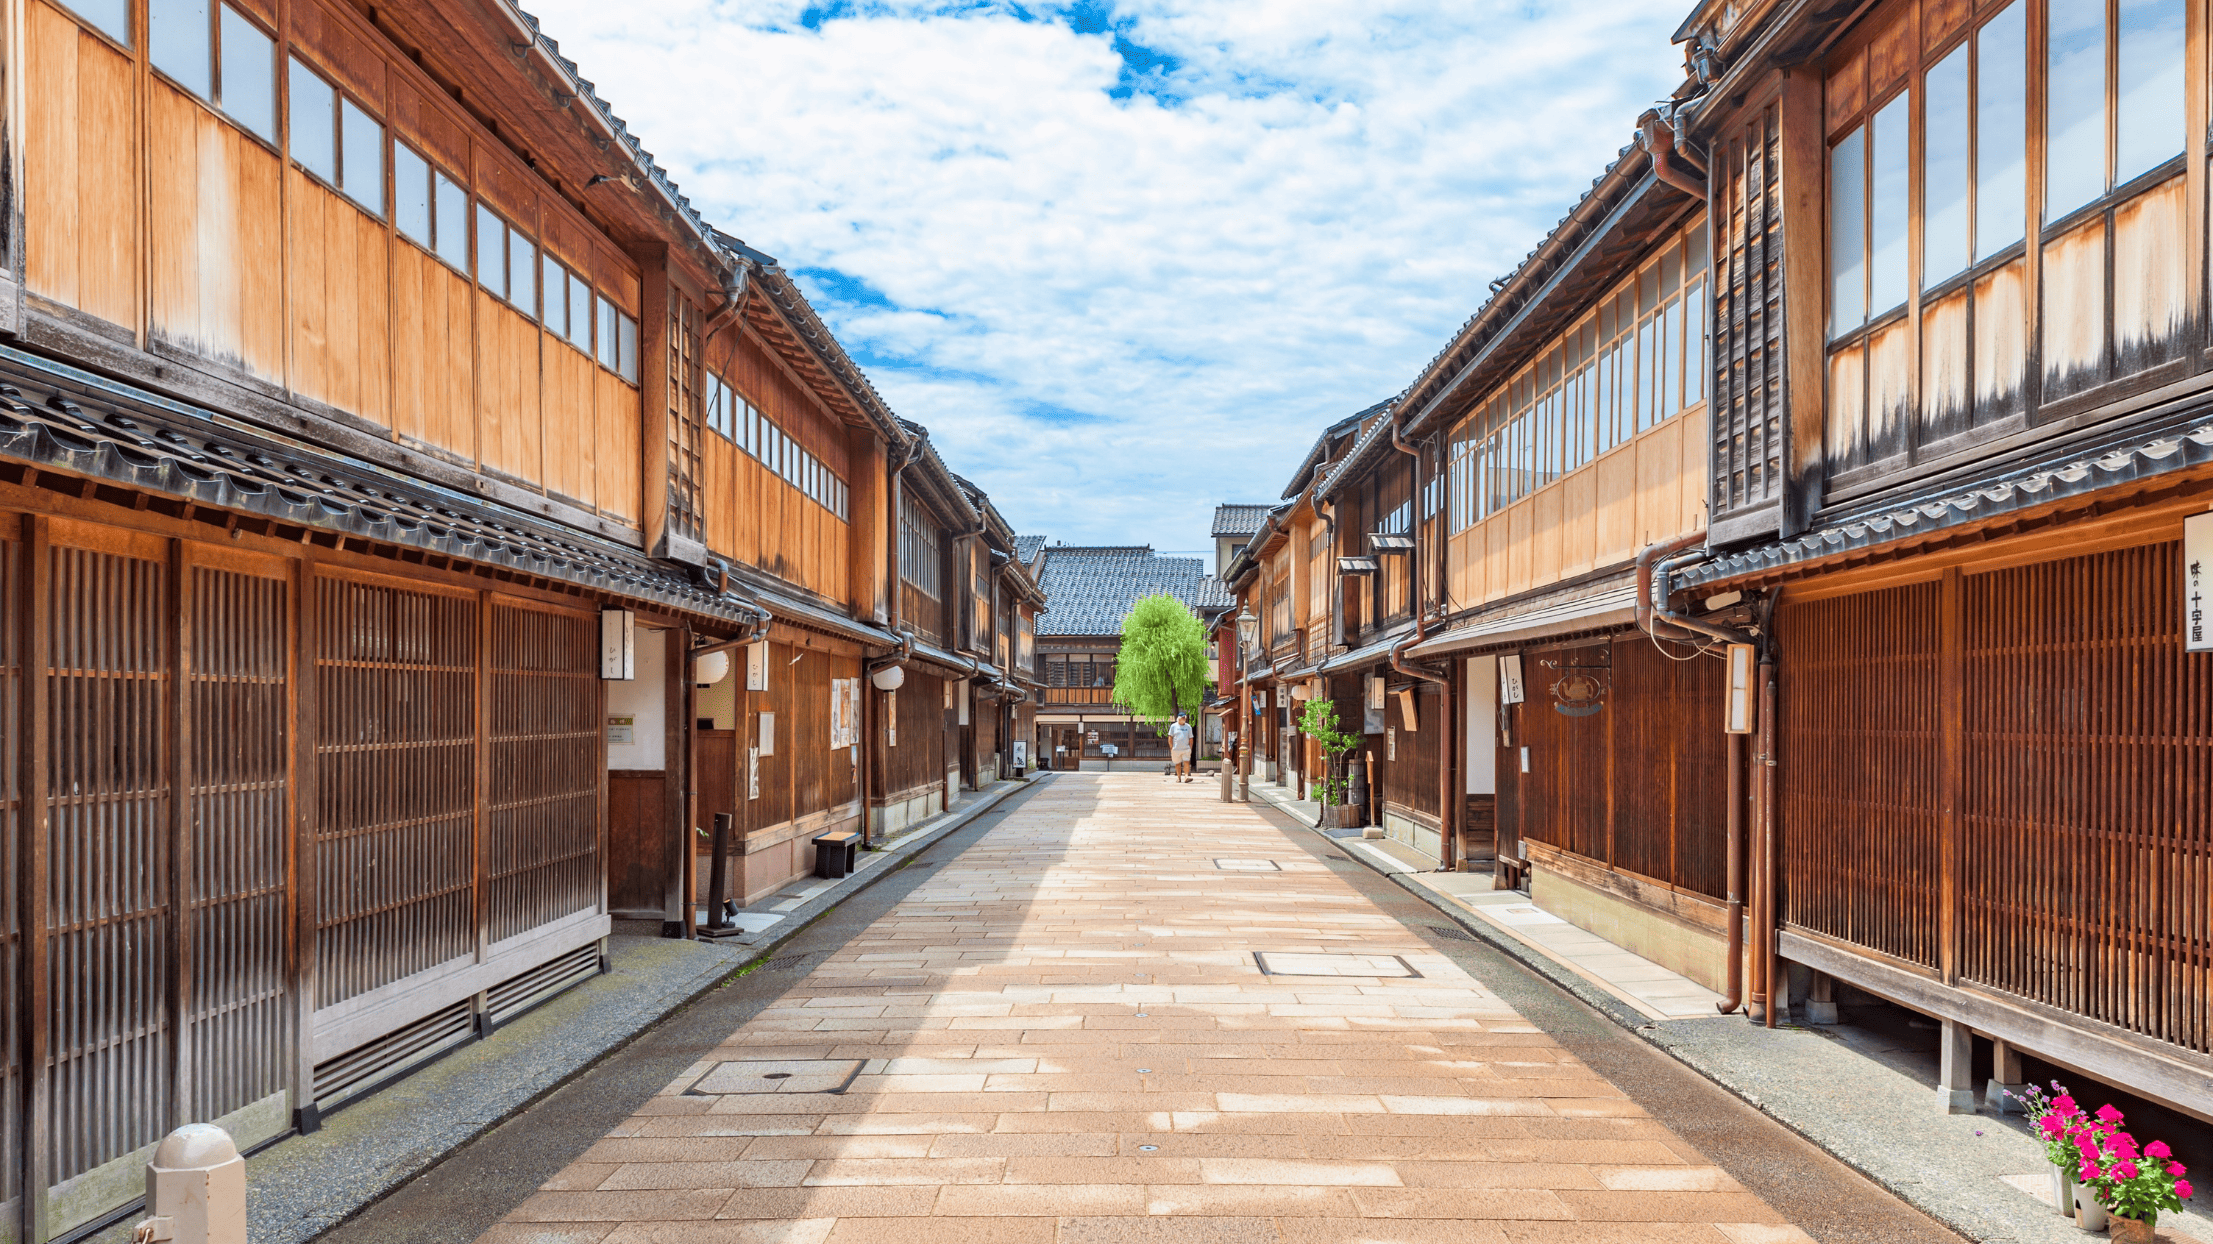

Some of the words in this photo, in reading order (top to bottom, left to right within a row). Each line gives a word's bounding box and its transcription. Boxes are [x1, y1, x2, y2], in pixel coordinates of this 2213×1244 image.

[2190, 560, 2203, 643] 味の十字屋
[609, 646, 617, 675] ひがし
[1511, 677, 1519, 699] ひがし
